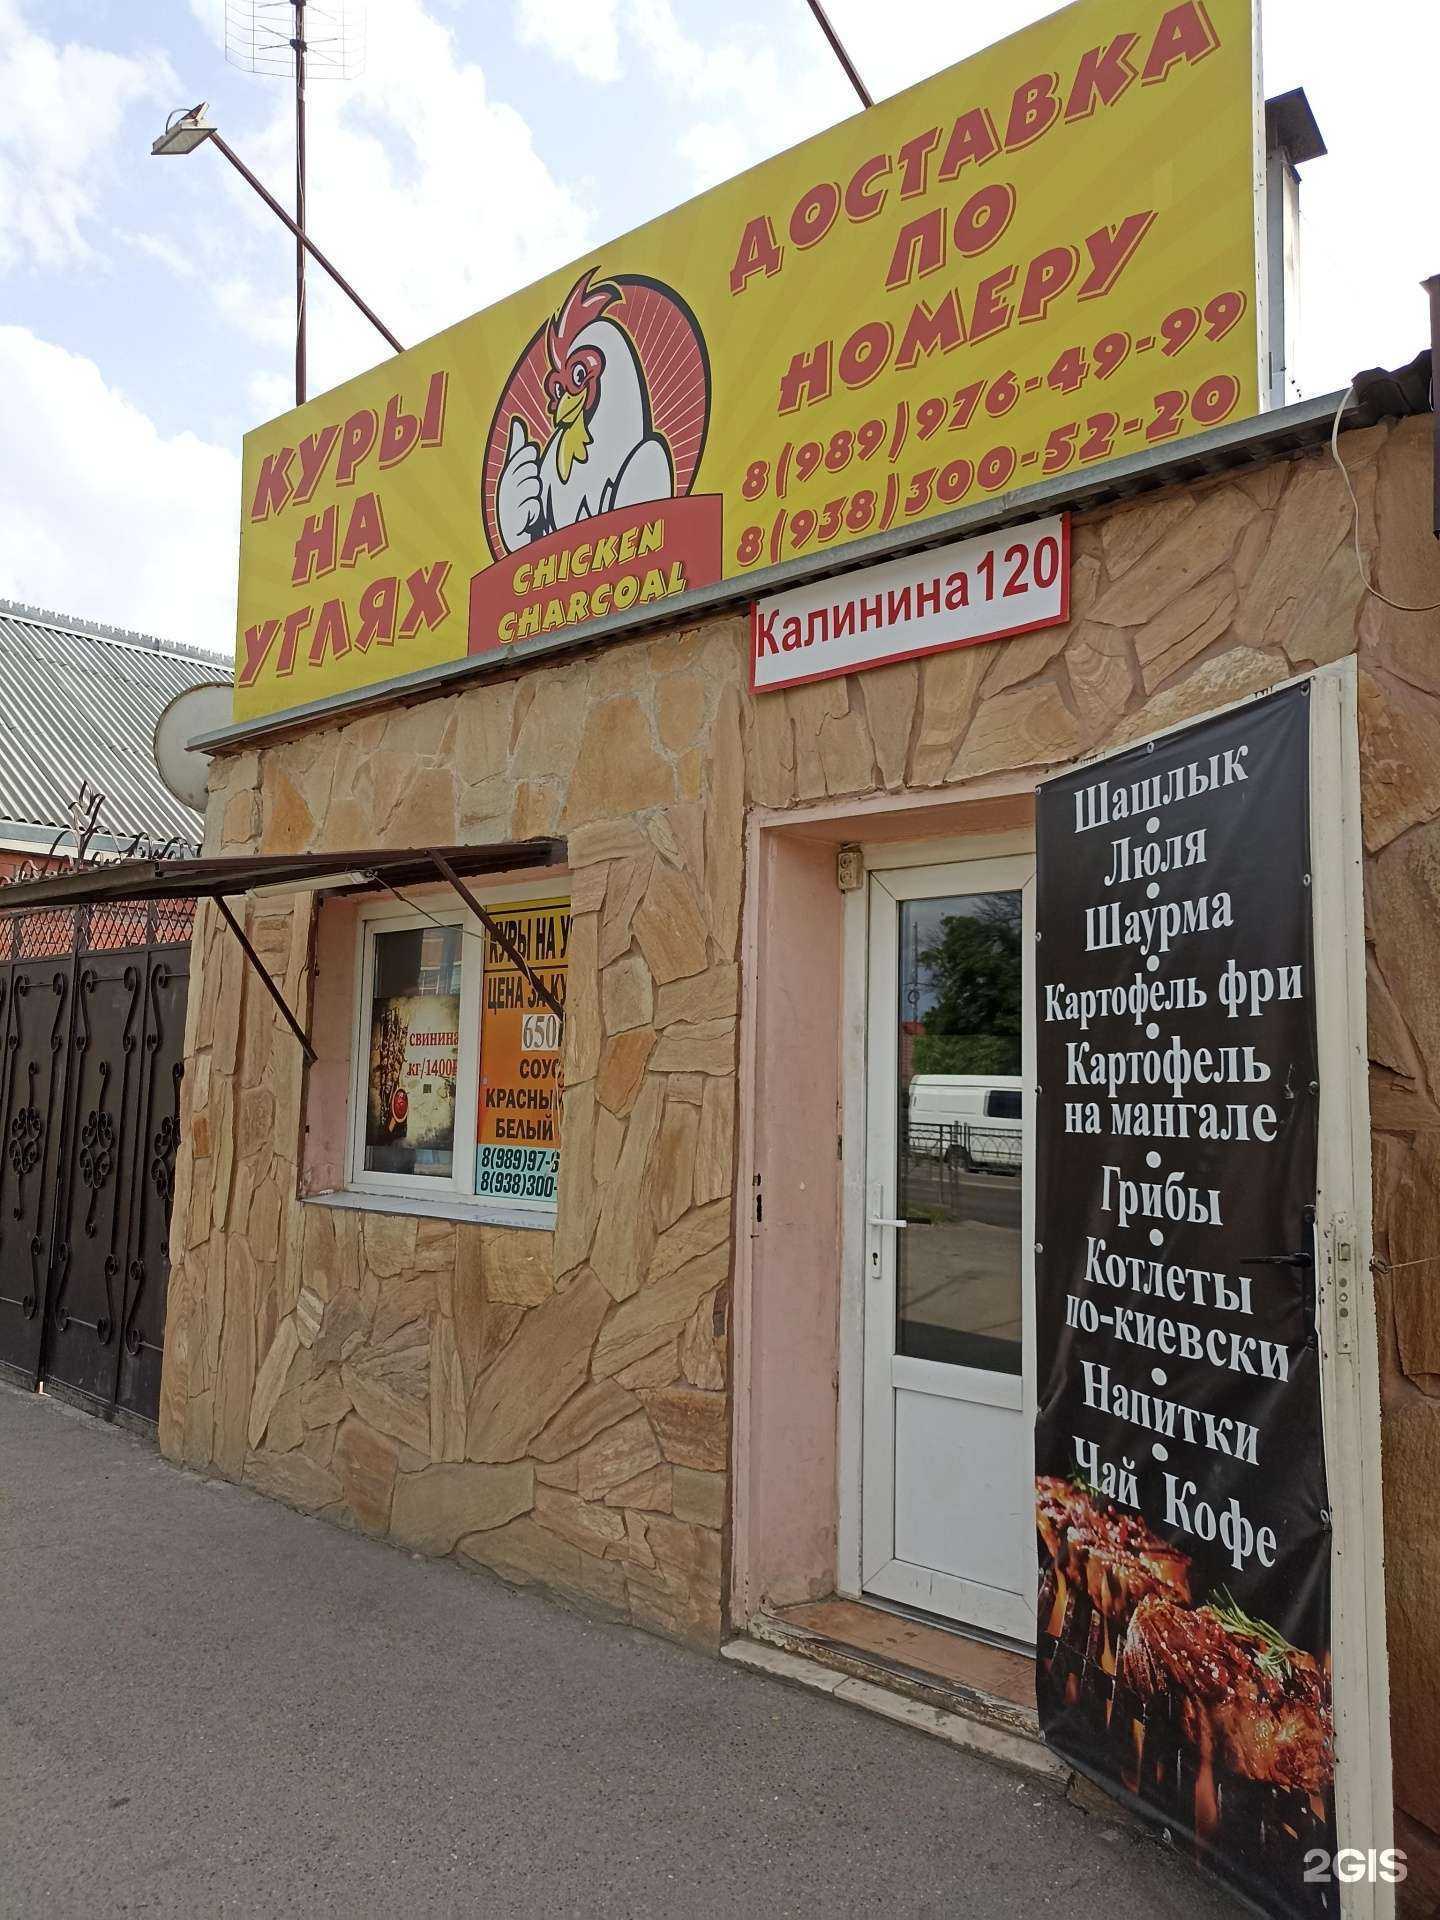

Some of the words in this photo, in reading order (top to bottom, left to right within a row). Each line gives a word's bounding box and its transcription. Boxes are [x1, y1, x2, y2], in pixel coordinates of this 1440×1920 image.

[730, 0, 1221, 295] ДОСТАВКА
[885, 182, 1017, 291] ПО
[778, 210, 1158, 415] НОМЕРУ
[741, 290, 1247, 500] 8(989)976-49-99
[252, 371, 449, 523] КУРЫ
[736, 375, 1241, 567] 8(938)300-52-20
[292, 492, 389, 587] НА
[512, 519, 666, 596] CHICKEN
[239, 560, 452, 688] УГЛЯХ
[497, 560, 686, 644] CHARCOAL
[1073, 745, 1249, 834] Шашлык
[1104, 828, 1207, 886] Люля
[560, 915, 573, 958] У
[1085, 891, 1233, 956] Шаурма
[488, 976, 524, 1015] ЦЕНА
[551, 973, 567, 1006] КУ
[523, 1015, 557, 1049] 650
[1044, 973, 1207, 1030] Картофель
[1218, 959, 1303, 1018] фри
[1065, 1036, 1271, 1098] Картофель
[495, 1113, 553, 1141] БЕЛЫЙ
[1064, 1102, 1101, 1135] на
[1111, 1102, 1277, 1142] мангале
[480, 1170, 558, 1198] 8(938)300-
[1100, 1165, 1224, 1228] Грибы
[1084, 1236, 1254, 1315] Котлеты
[1065, 1294, 1289, 1382] по-киевски
[1080, 1360, 1260, 1466] Напитки
[1072, 1436, 1141, 1509] Чай
[1162, 1472, 1278, 1571] Кофе
